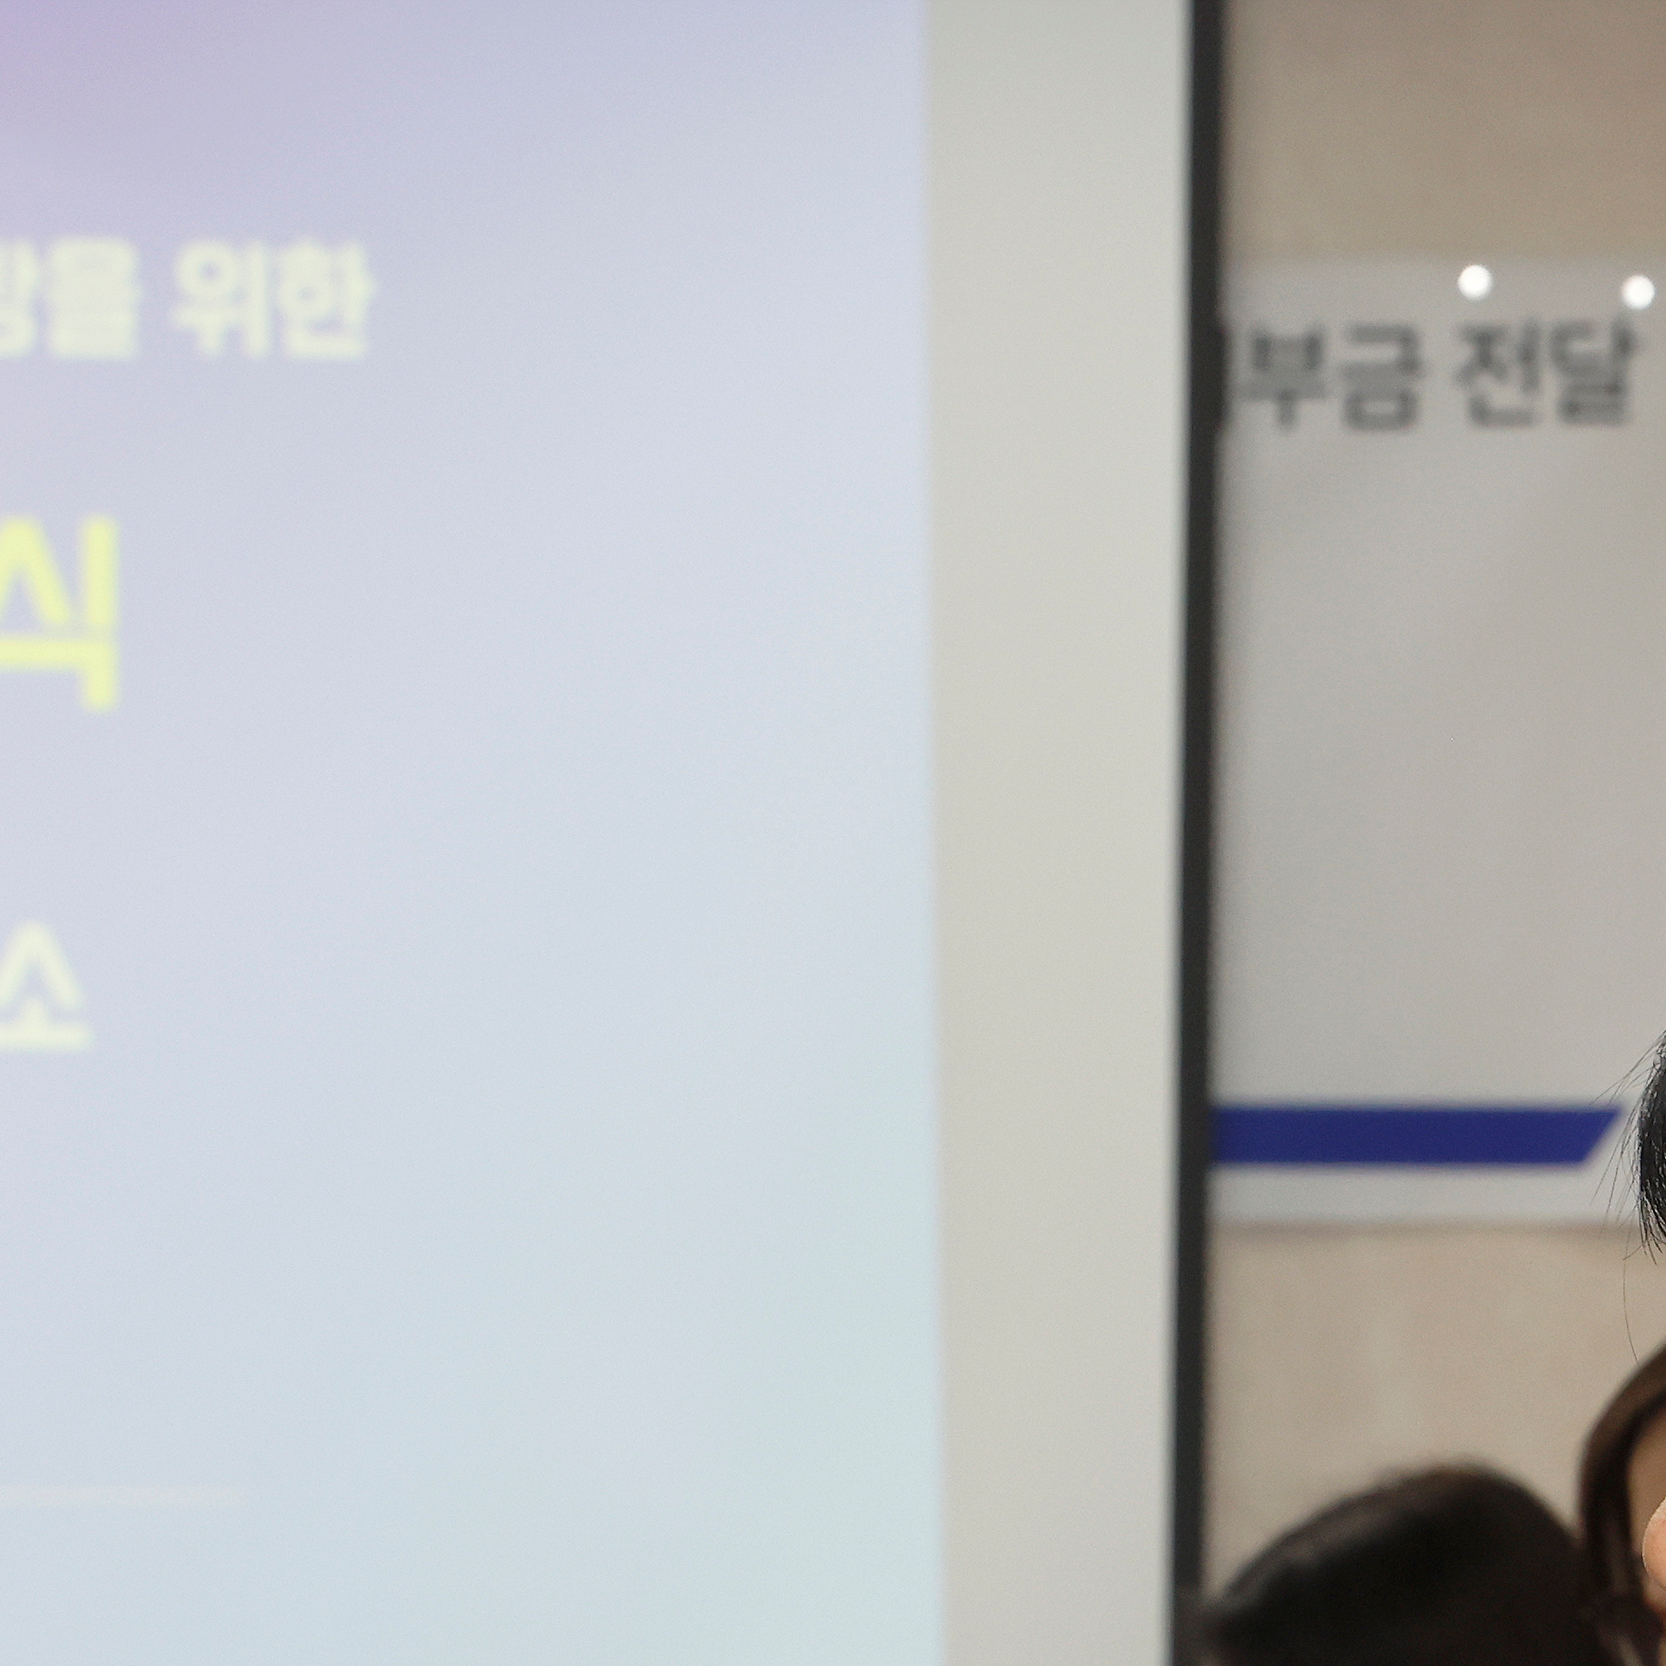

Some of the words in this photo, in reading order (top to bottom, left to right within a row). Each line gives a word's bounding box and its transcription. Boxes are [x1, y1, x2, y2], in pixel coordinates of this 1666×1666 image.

[172, 238, 374, 357] 위한
[1223, 322, 1421, 432] 부금
[1455, 316, 1639, 428] 전달
